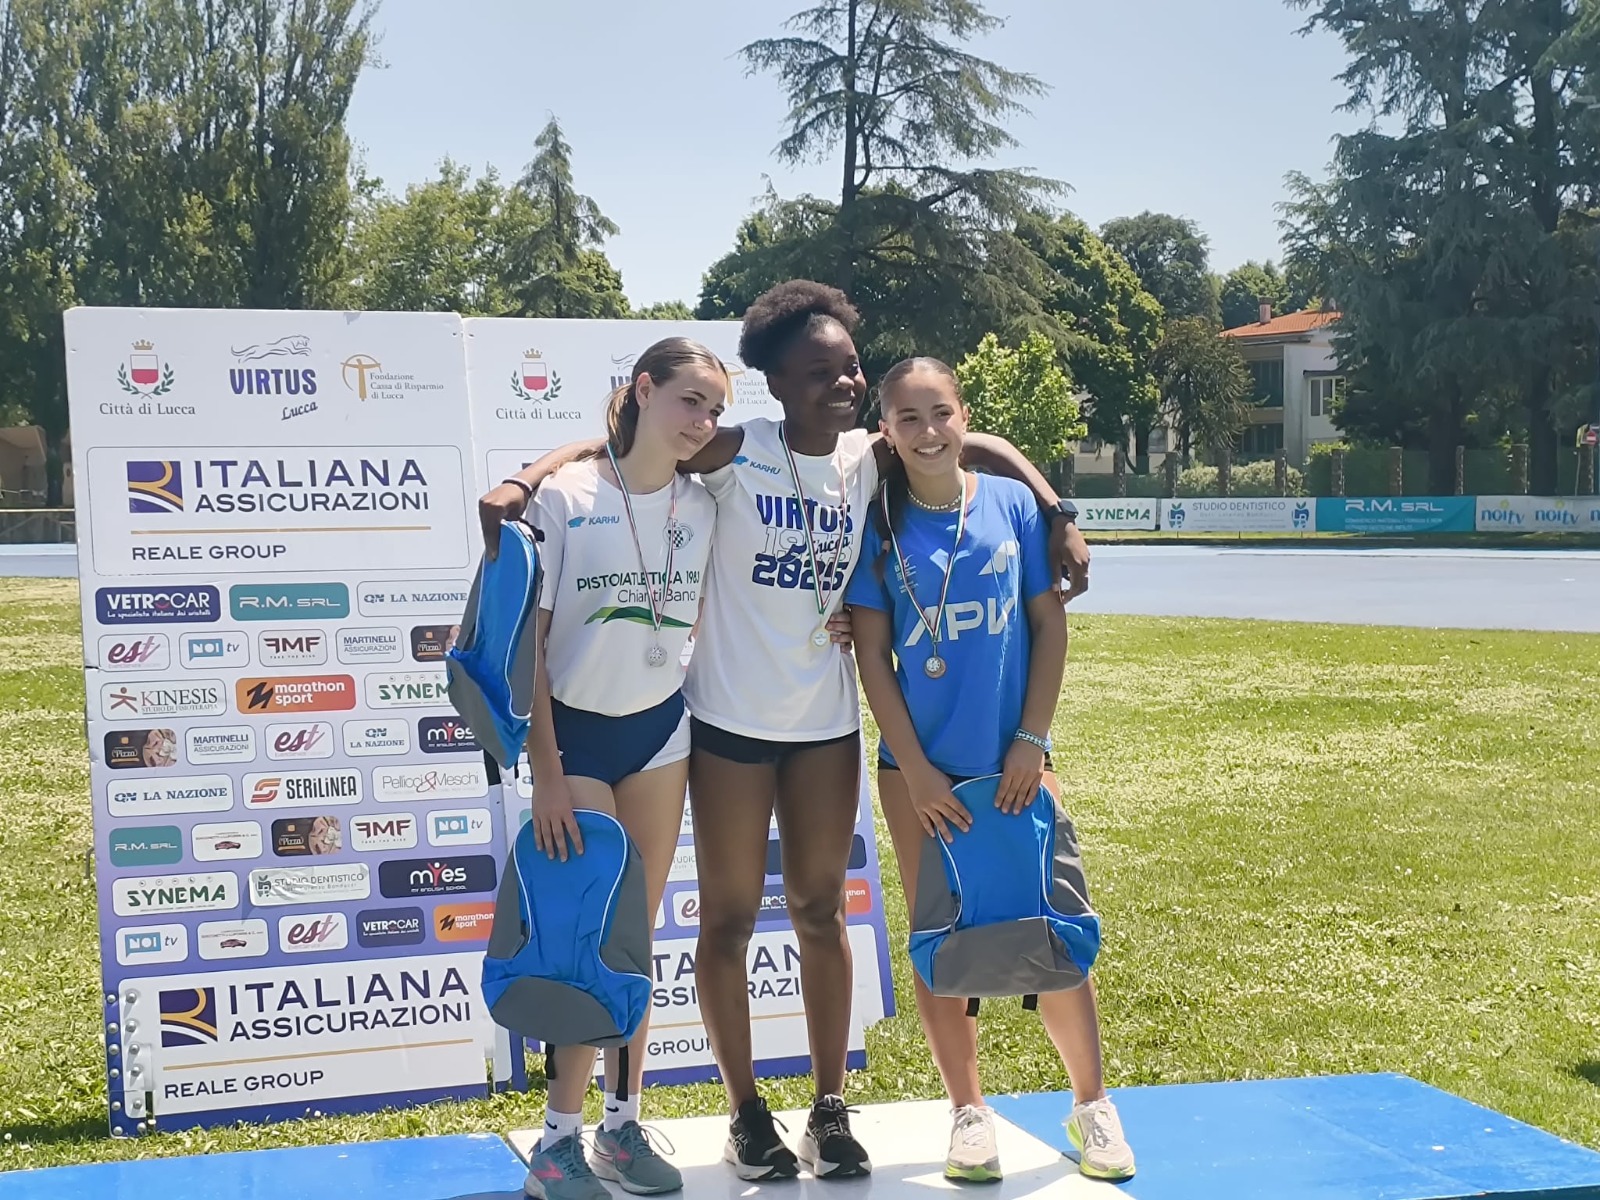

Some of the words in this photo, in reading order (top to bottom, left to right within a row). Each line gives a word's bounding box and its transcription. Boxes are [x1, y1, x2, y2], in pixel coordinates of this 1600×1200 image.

[229, 368, 317, 396] VIRTUS
[370, 372, 414, 380] Fondazione
[370, 382, 393, 390] Cassa
[394, 382, 403, 390] di
[404, 382, 444, 392] Risparmio
[371, 391, 379, 399] di
[381, 391, 404, 400] Lucca
[99, 402, 133, 416] Città
[138, 402, 152, 416] di
[157, 402, 196, 416] Lucca
[281, 400, 319, 421] Lucca
[495, 406, 526, 420] Città
[530, 406, 543, 420] di
[547, 407, 581, 420] Lucca
[195, 459, 428, 489] ITALIANA
[750, 460, 781, 476] KARHU
[195, 491, 430, 513] ASSICURAZIONI
[1192, 501, 1227, 511] STUDIO
[1229, 501, 1286, 511] DENTISTICO
[1345, 499, 1397, 512] R.M.
[1401, 502, 1444, 512] SRL
[588, 515, 620, 526] KARHU
[756, 493, 853, 534] VIRTUS
[1086, 508, 1150, 520] SYNEMA
[132, 546, 202, 561] REALE
[208, 544, 287, 559] GROUP
[752, 552, 850, 591] 2025
[107, 592, 210, 609] VETROCAR
[239, 595, 293, 609] R.M.
[296, 597, 341, 607] SRL
[390, 594, 408, 602] LA
[411, 592, 468, 602] NAZIONE
[343, 635, 397, 645] MARTINELLI
[107, 635, 161, 664] est
[191, 643, 220, 653] NOI
[226, 642, 240, 652] tv
[343, 644, 397, 653] ASSICURAZIONI
[274, 681, 345, 695] marathon
[378, 682, 450, 701] SYNEM
[141, 687, 218, 706] KINESIS
[275, 692, 313, 706] sport
[193, 734, 249, 744] MARTINELLI
[274, 724, 325, 752] est
[350, 741, 364, 749] LA
[365, 740, 405, 748] NAZIONE
[193, 744, 250, 754] ASSICURAZIONI
[143, 792, 161, 801] LA
[167, 787, 228, 800] NAZIONE
[438, 819, 465, 831] NOI
[471, 819, 483, 830] tv
[151, 841, 178, 850] SRL
[310, 873, 364, 885] DENTISTICO
[127, 884, 226, 908] SYNEMA
[455, 912, 494, 923] marathon
[287, 914, 339, 945] est
[362, 918, 419, 932] VETROCAR
[455, 920, 478, 930] sport
[129, 937, 157, 949] NOI
[164, 935, 178, 947] tv
[229, 967, 470, 1015] ITALIANA
[229, 1002, 471, 1042] ASSICURAZIONI
[164, 1078, 237, 1099] REALE
[244, 1070, 324, 1092] GROUP
